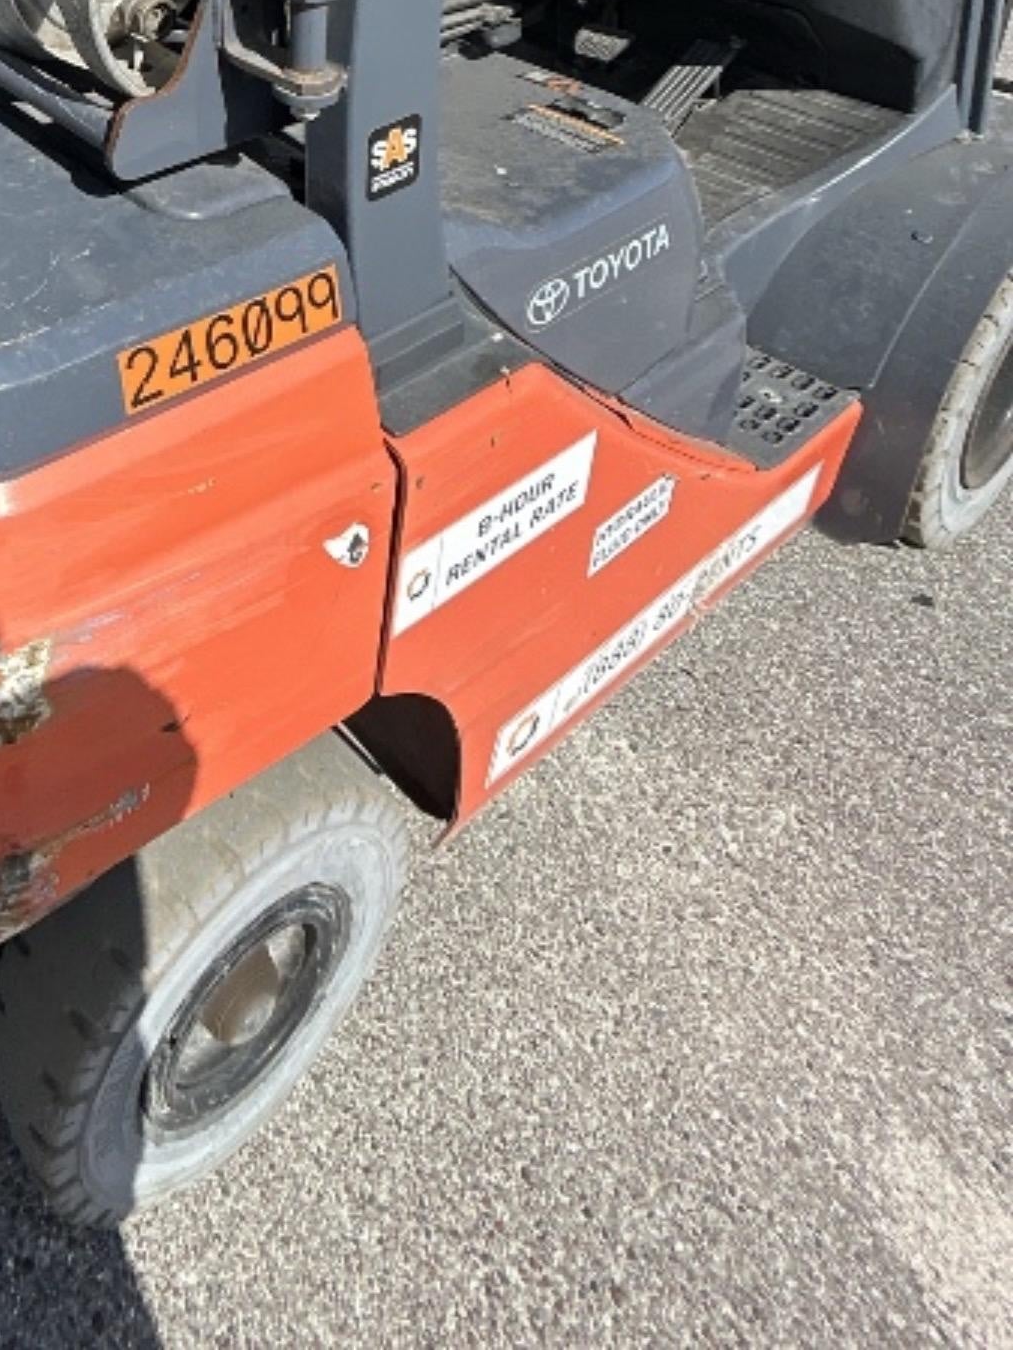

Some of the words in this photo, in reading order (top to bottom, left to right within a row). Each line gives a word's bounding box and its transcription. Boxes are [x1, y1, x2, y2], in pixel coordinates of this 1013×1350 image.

[370, 126, 418, 172] SAS
[573, 223, 670, 299] TOYOTA
[126, 271, 340, 409] 246099
[445, 521, 522, 587] RENTAL
[529, 479, 579, 529] RATE
